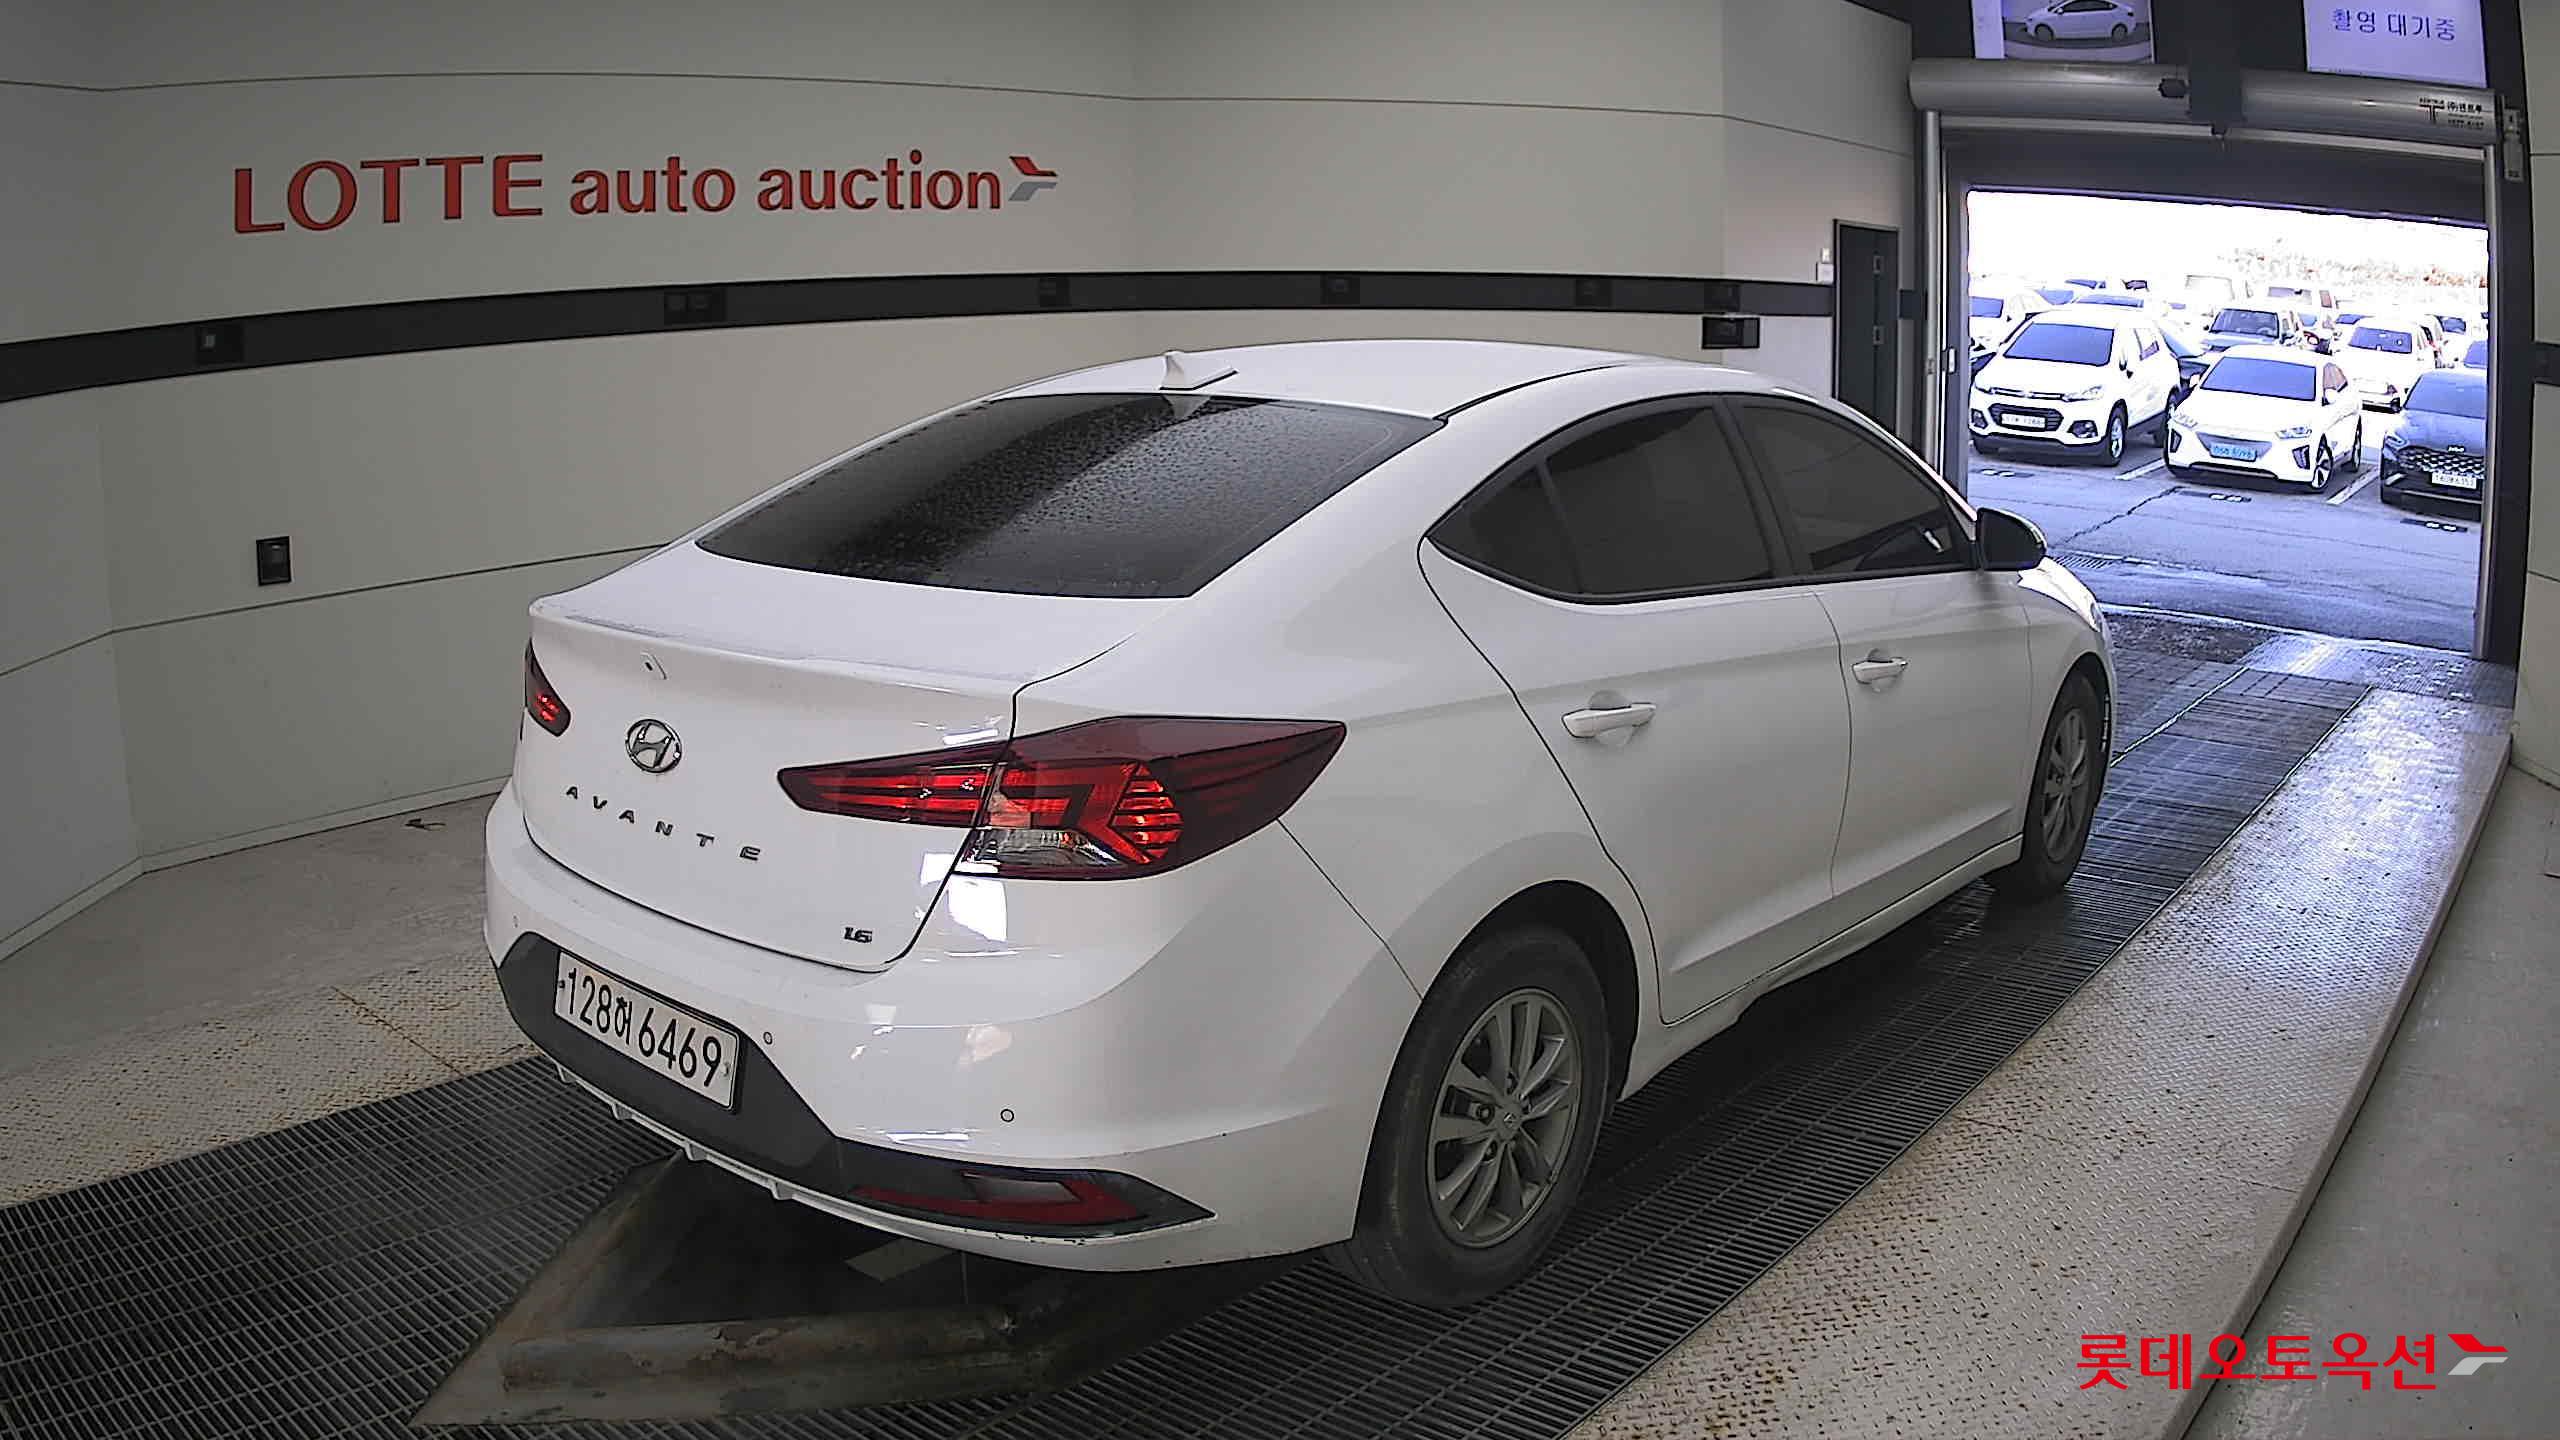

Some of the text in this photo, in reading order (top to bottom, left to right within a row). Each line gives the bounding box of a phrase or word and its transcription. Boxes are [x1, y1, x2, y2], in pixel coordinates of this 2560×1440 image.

[2387, 13, 2456, 41] 대기중
[234, 149, 1002, 234] LOTTE auto auction
[566, 786, 761, 861] AVANTE
